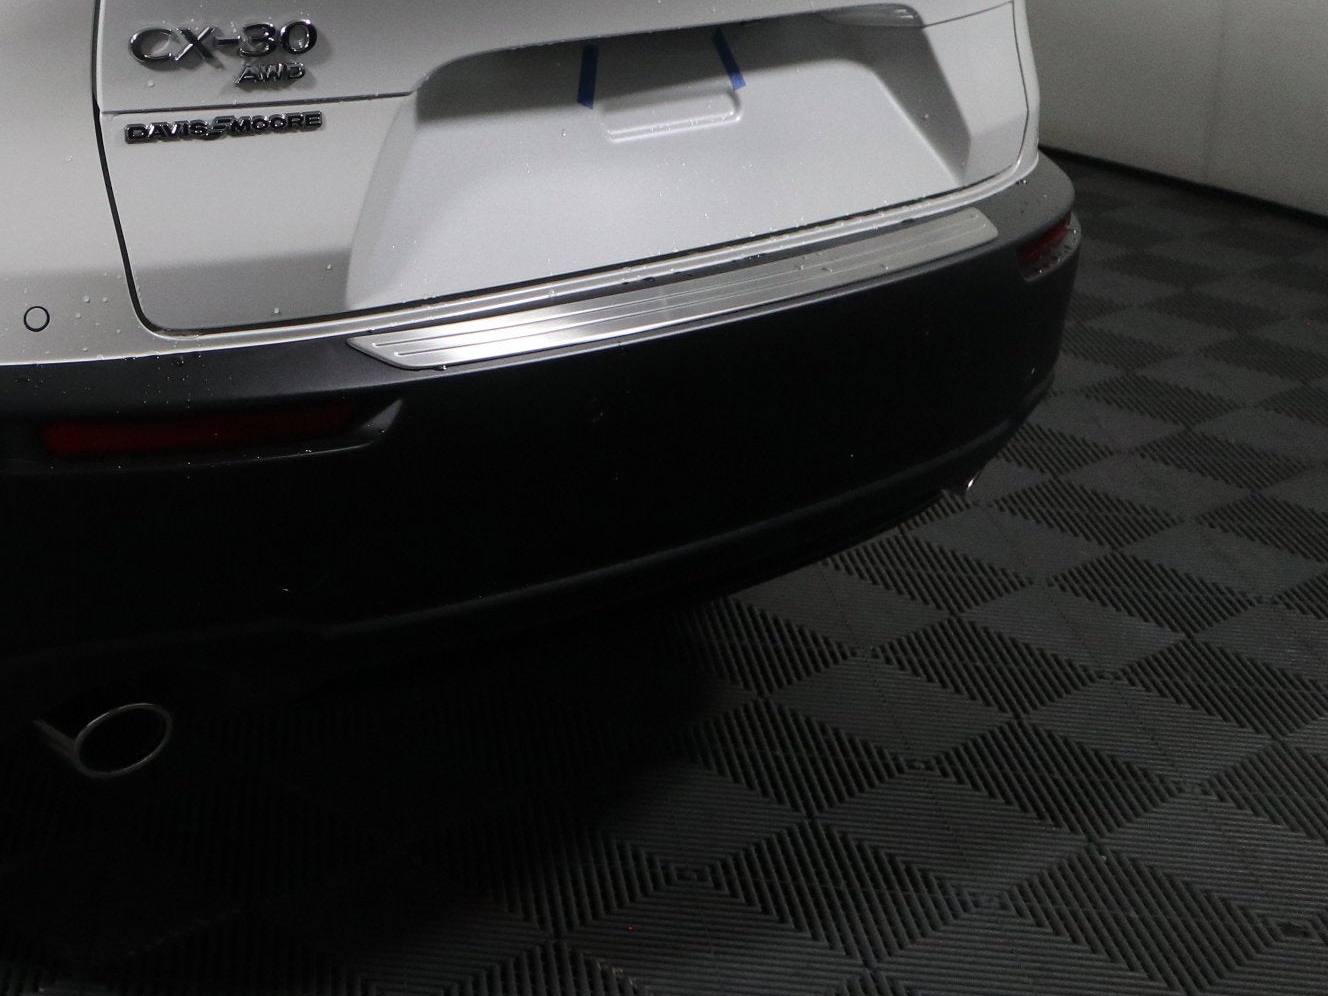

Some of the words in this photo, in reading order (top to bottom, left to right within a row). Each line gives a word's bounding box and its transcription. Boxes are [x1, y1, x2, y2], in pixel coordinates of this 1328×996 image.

[128, 19, 318, 67] CX-30
[233, 61, 306, 88] AWD
[124, 120, 210, 144] DAVIS
[228, 110, 324, 136] MOORE
